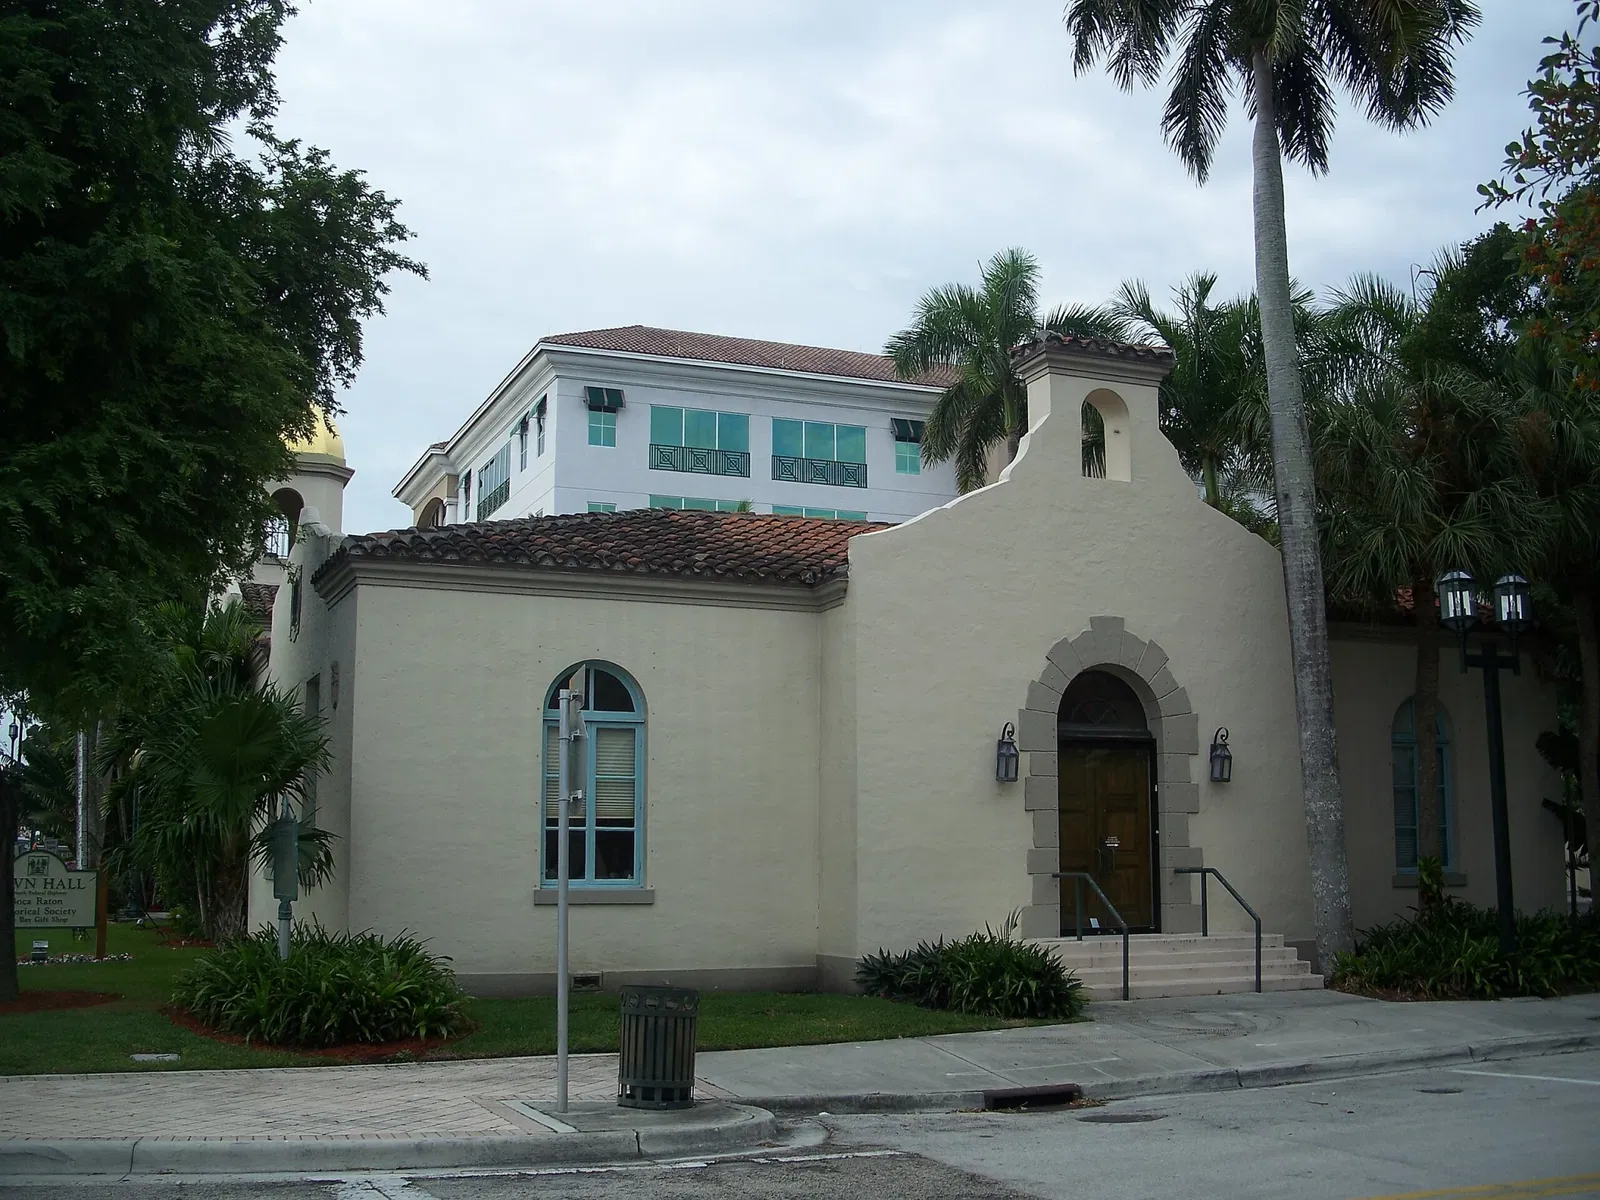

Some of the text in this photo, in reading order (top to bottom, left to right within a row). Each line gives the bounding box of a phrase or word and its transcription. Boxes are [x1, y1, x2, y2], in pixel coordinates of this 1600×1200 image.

[44, 878, 86, 890] HALL
[36, 896, 63, 905] Raton
[44, 906, 76, 916] Society
